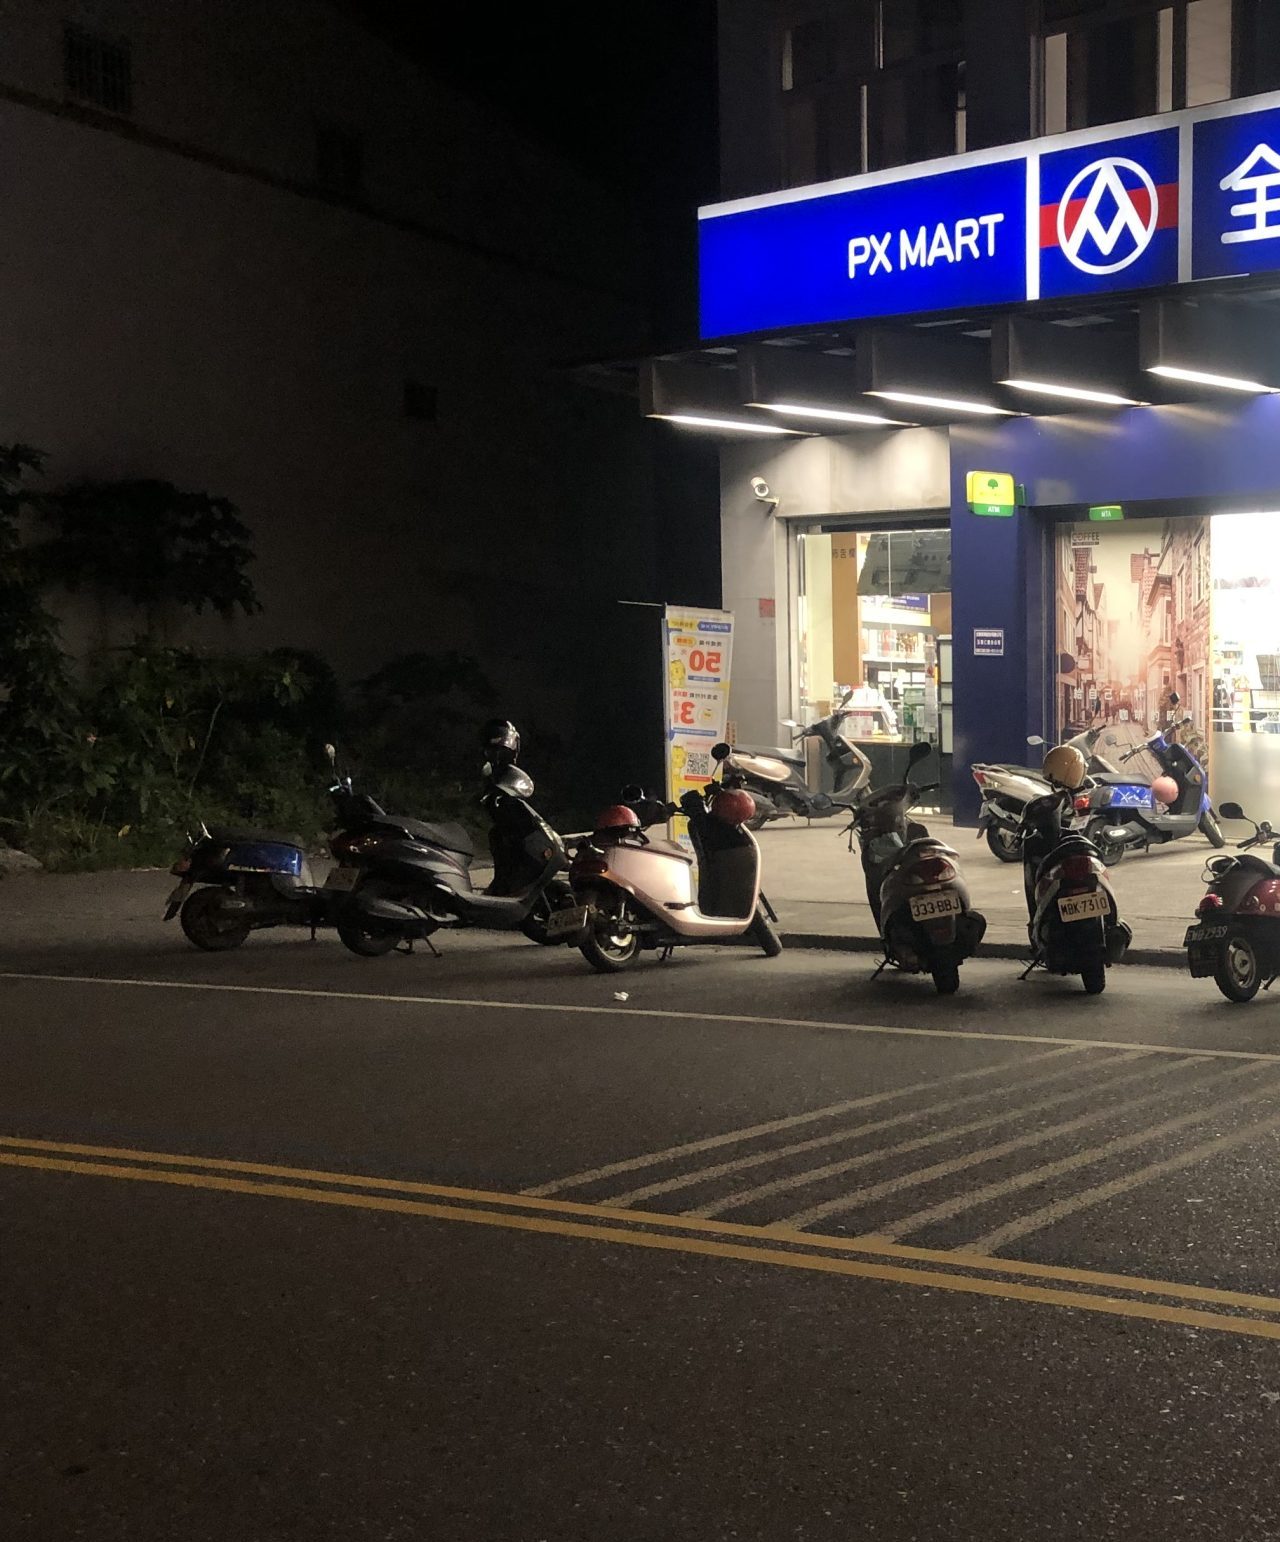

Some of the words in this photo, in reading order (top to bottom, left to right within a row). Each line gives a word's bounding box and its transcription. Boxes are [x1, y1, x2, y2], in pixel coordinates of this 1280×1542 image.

[848, 234, 893, 280] PX
[900, 212, 1005, 270] MART
[987, 505, 1001, 513] ATM
[1072, 531, 1100, 541] COFFEE
